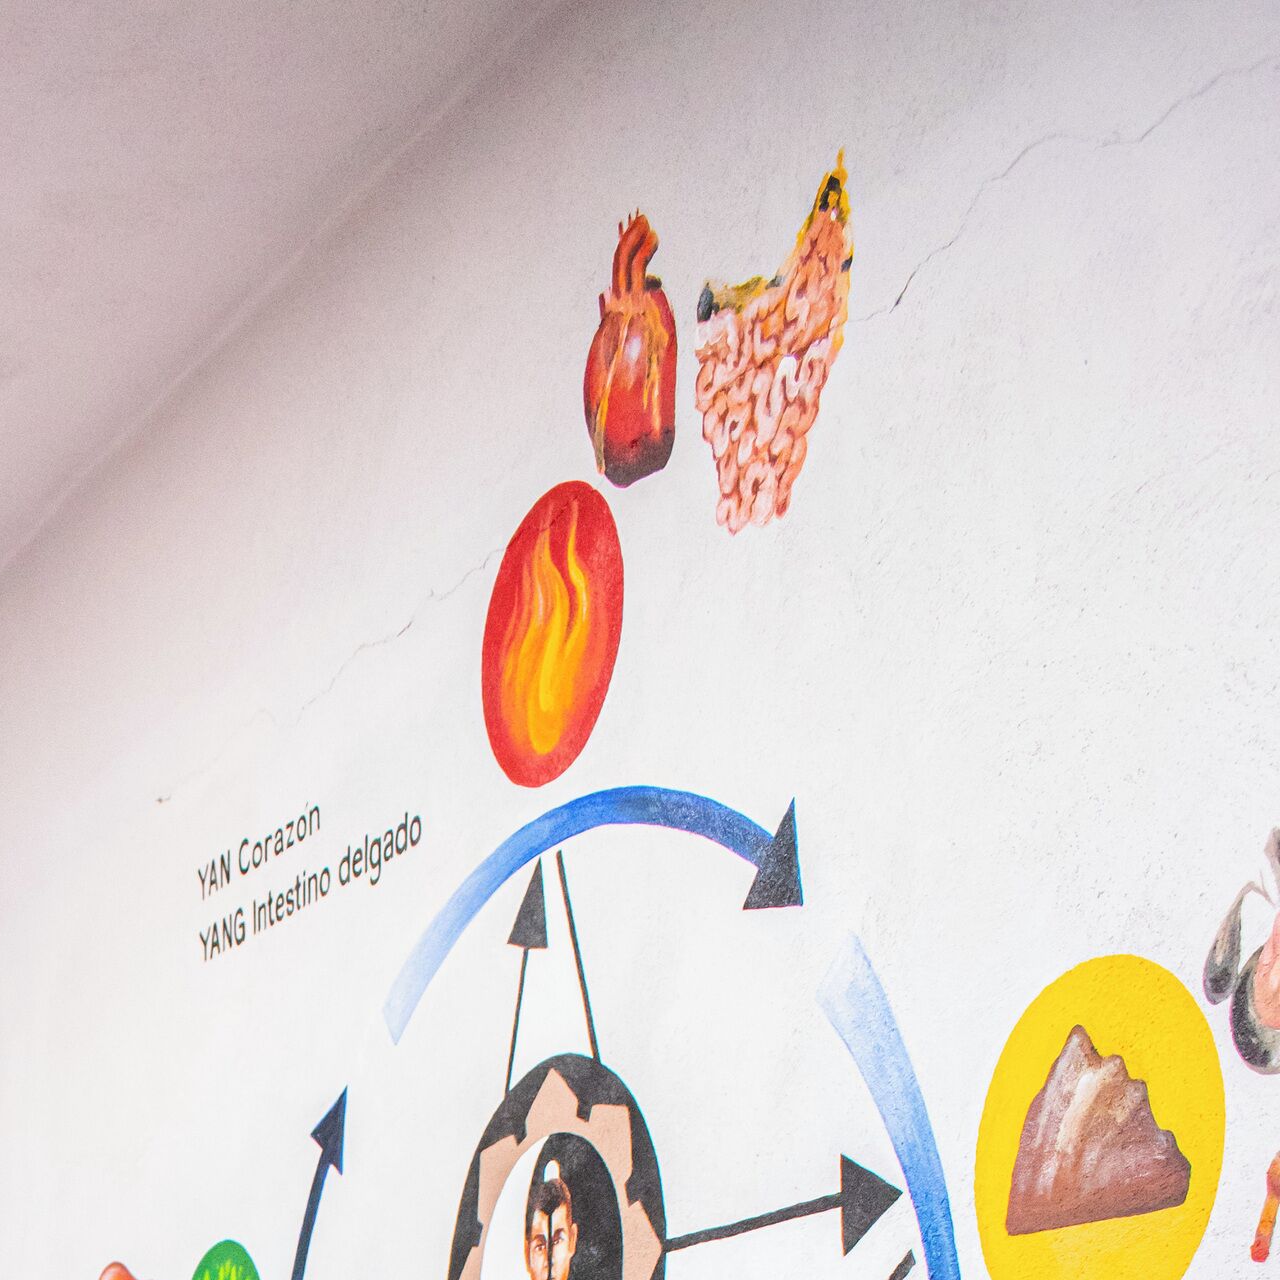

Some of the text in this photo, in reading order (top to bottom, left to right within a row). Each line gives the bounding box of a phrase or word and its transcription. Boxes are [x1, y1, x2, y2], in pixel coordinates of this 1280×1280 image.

[198, 801, 320, 900] YAN Corazón
[199, 811, 422, 961] YANG Intestino delgado
